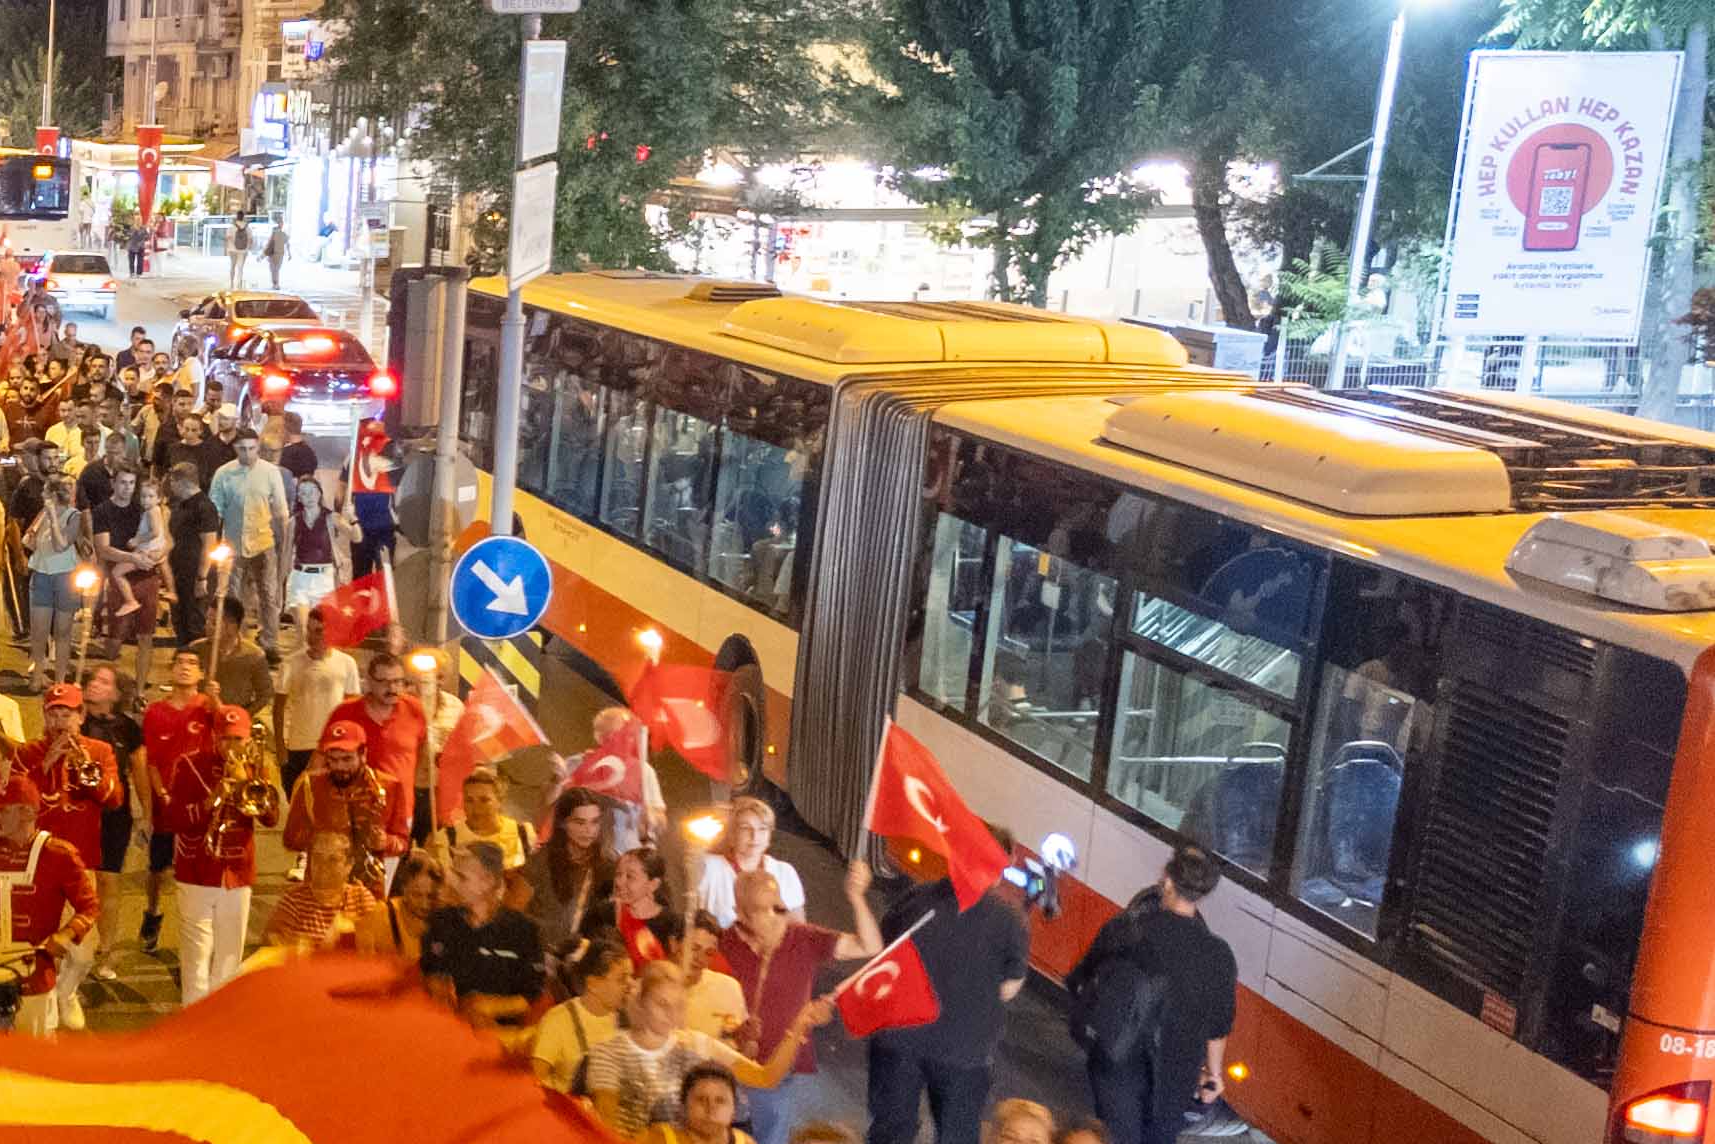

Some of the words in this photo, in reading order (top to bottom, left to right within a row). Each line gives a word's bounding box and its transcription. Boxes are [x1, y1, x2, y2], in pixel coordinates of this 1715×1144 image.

[1477, 155, 1498, 197] HEP
[1489, 96, 1570, 151] KULLAN
[1577, 96, 1620, 122] HEP
[1613, 121, 1643, 195] KAZAN
